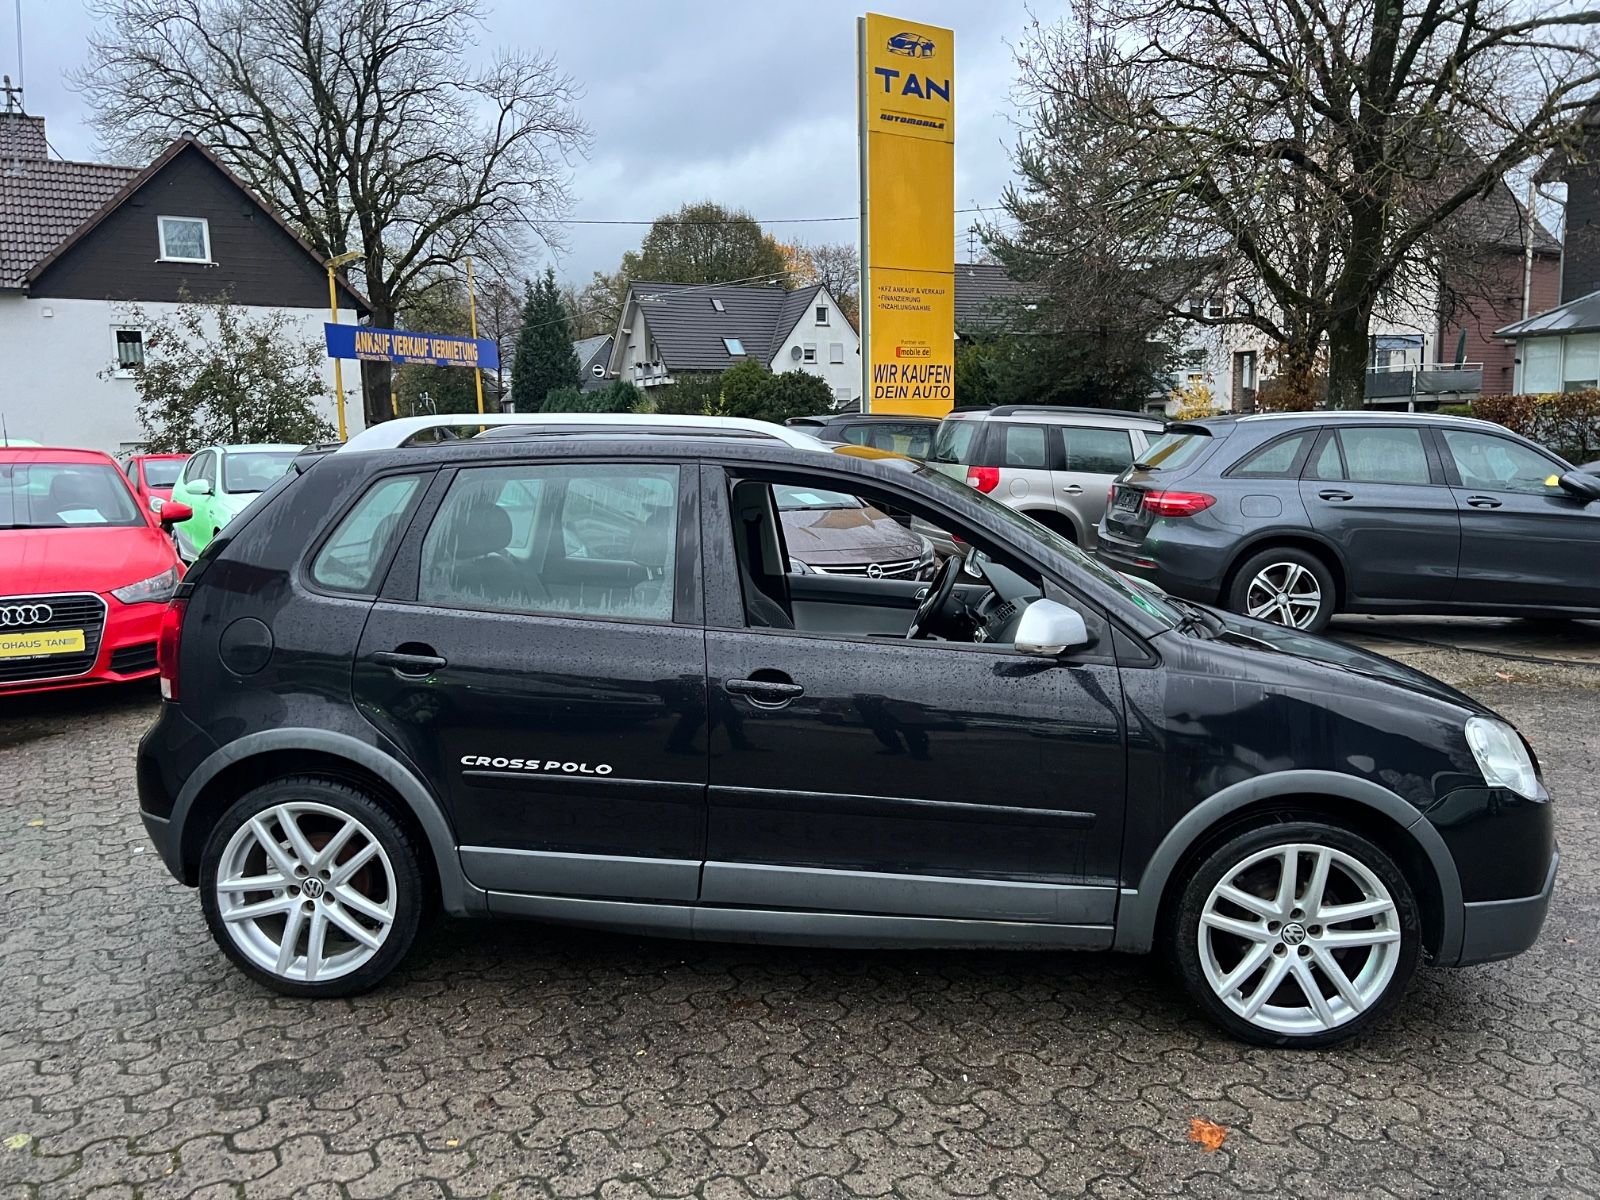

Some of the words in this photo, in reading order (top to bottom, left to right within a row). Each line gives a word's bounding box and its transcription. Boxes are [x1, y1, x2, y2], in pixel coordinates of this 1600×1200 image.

[874, 66, 950, 102] TAN
[880, 113, 945, 130] AUTOMOBILE
[893, 286, 915, 294] ANKAUF
[881, 295, 921, 303] FINANZIERUNG
[355, 331, 391, 355] ANKAUF
[392, 335, 430, 358] VERKAUF
[430, 339, 478, 361] VERMIETUNG
[874, 364, 898, 383] WIR
[901, 365, 951, 384] KAUFEN
[874, 386, 908, 399] DEIN
[912, 386, 950, 399] AUTO
[0, 640, 41, 650] OHAUS
[460, 755, 540, 770] CROSS
[543, 760, 613, 775] POLO
